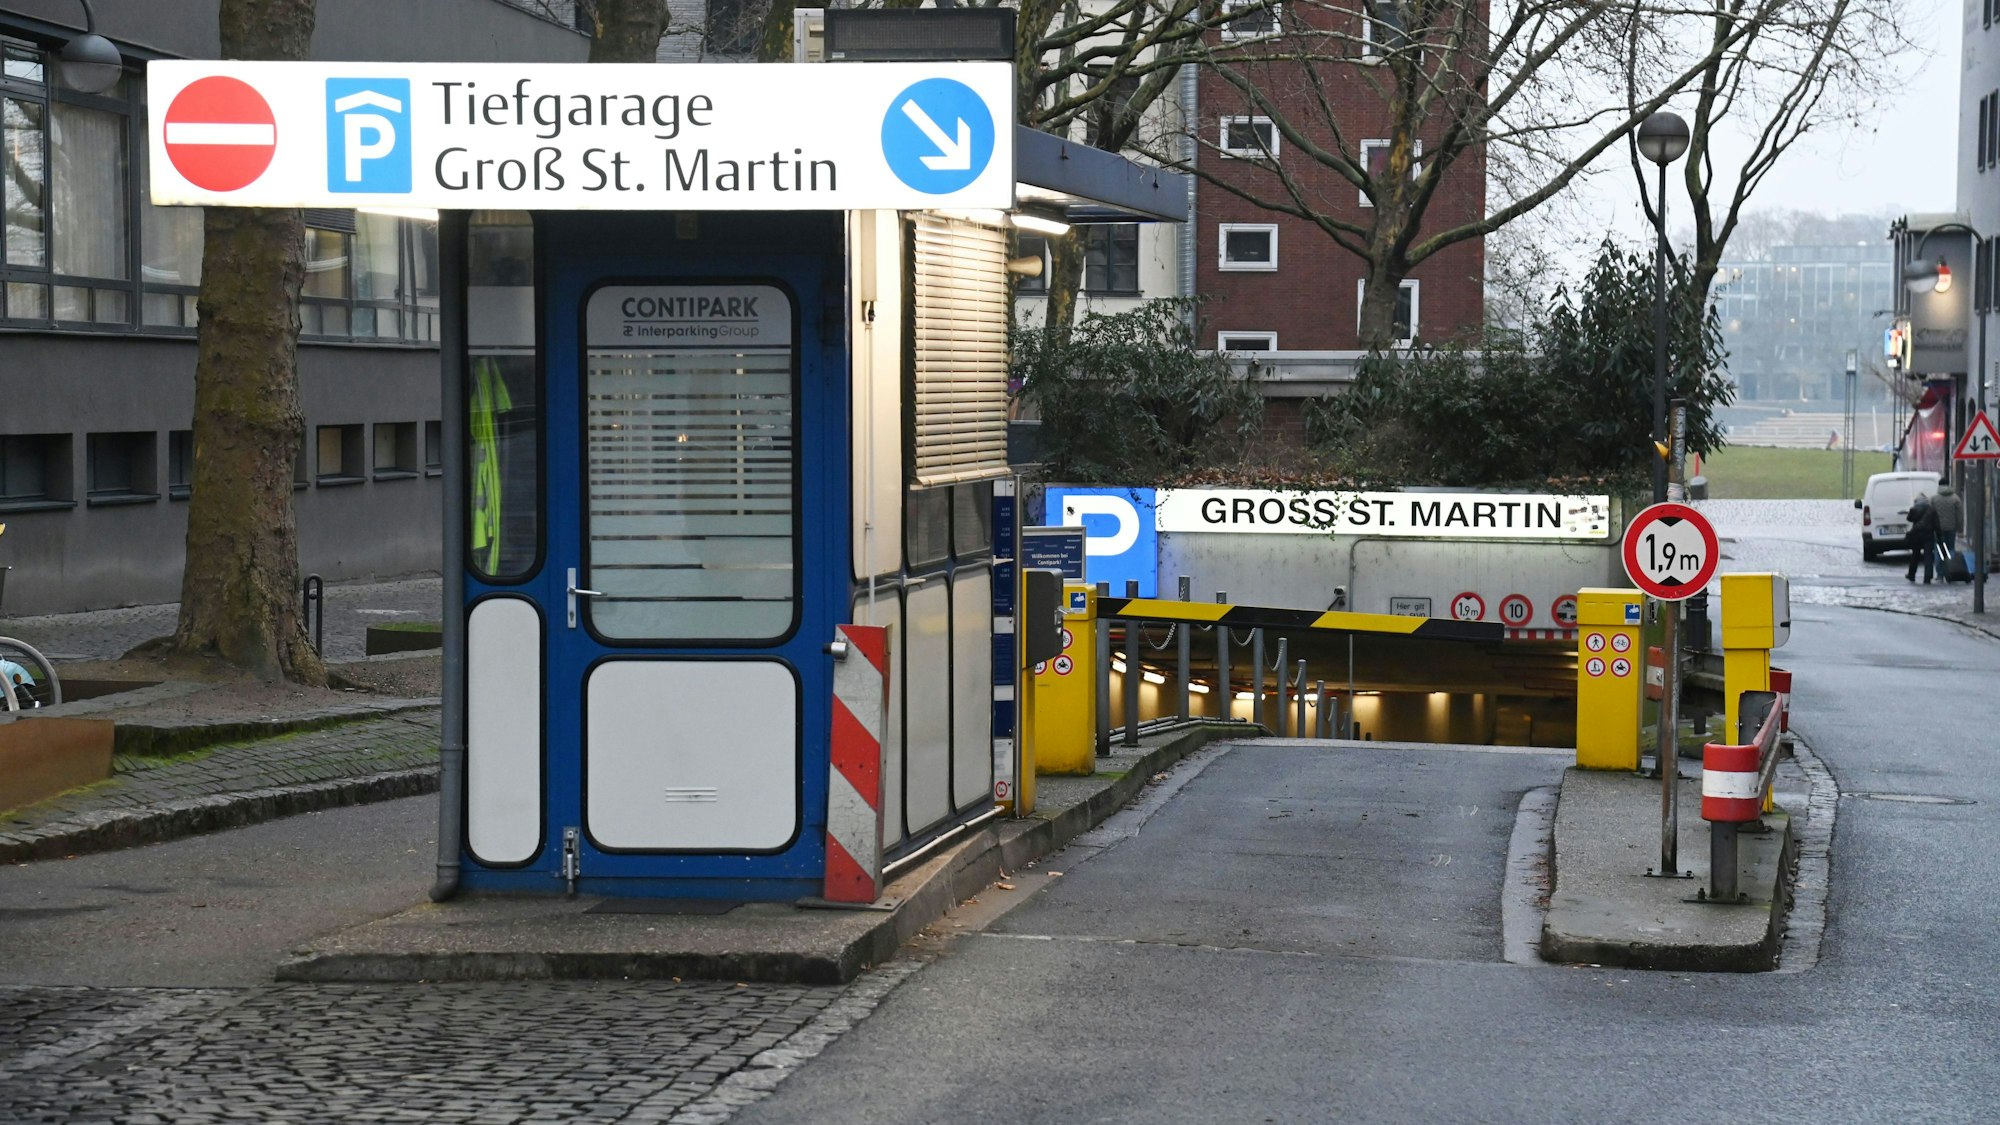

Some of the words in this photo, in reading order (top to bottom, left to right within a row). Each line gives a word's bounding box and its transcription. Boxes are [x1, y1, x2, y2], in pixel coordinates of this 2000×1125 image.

[432, 79, 713, 140] Tiefgarage
[344, 113, 396, 182] P
[435, 146, 565, 192] Groß
[582, 146, 645, 192] St.
[665, 147, 837, 192] Martin
[621, 297, 759, 318] CONTIPARK
[1063, 495, 1139, 556] P
[1201, 498, 1336, 527] GROSS
[1348, 499, 1395, 526] ST.
[1411, 501, 1561, 528] MARTIN
[1414, 603, 1425, 611] gilt
[1509, 603, 1523, 618] 10
